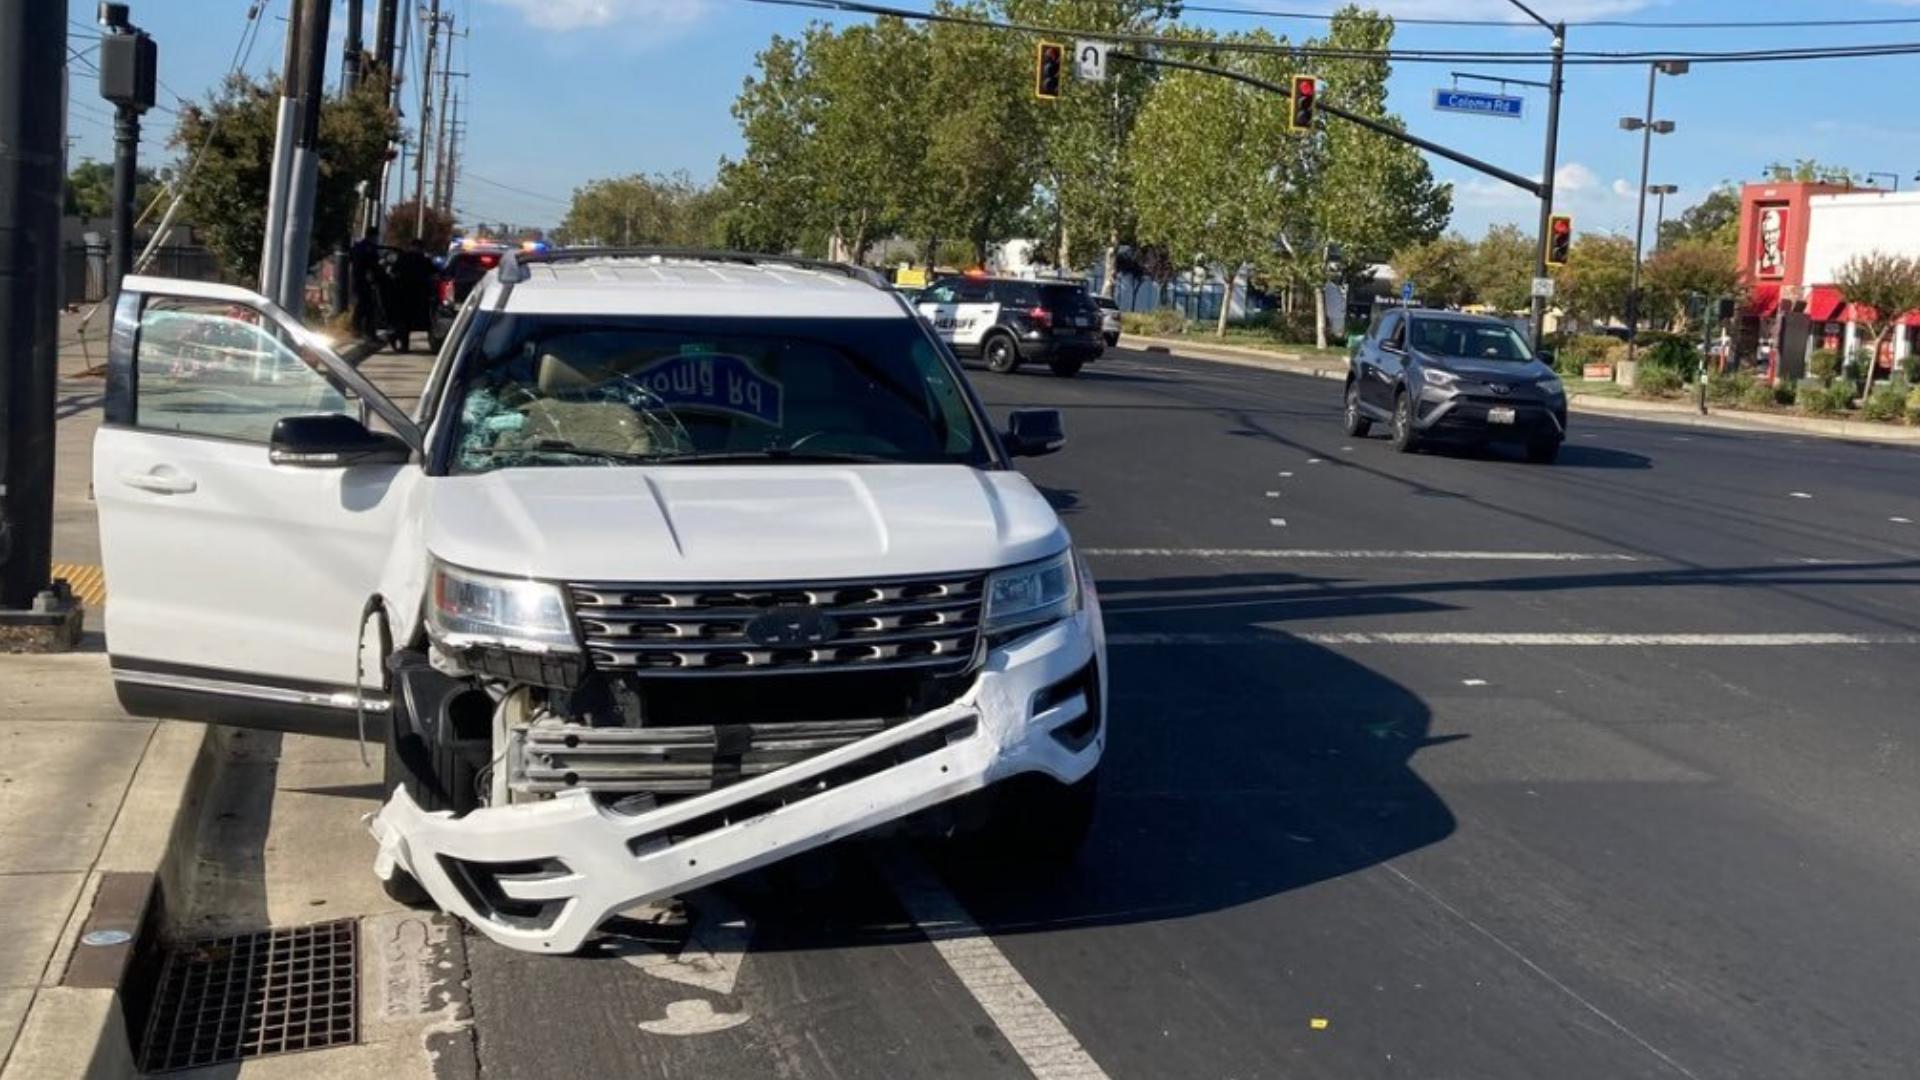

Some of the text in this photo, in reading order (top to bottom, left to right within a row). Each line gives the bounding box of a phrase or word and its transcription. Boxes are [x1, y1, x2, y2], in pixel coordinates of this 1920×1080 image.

[1448, 95, 1510, 112] Coloma Rd
[934, 318, 977, 329] HERIFF
